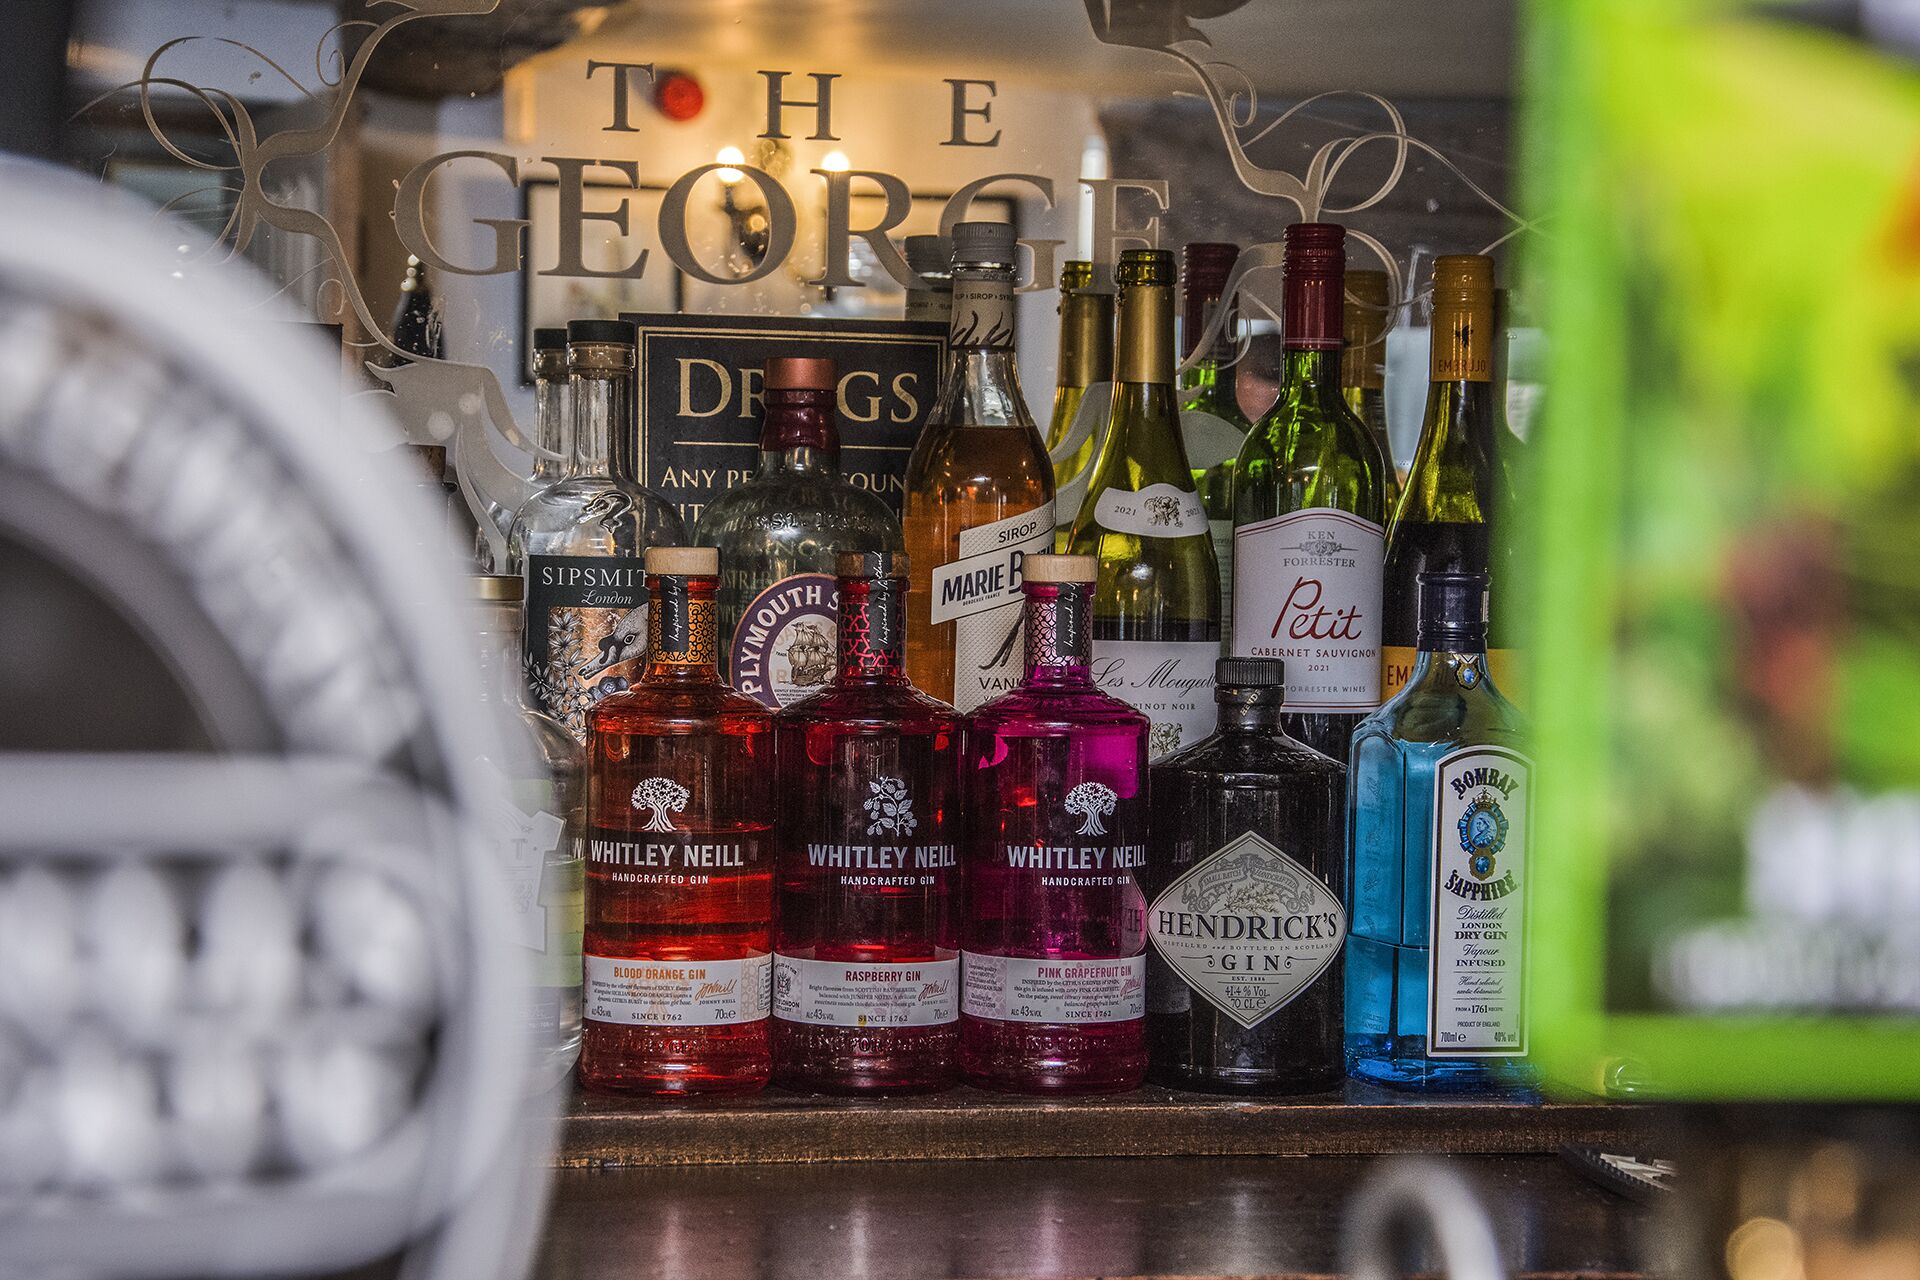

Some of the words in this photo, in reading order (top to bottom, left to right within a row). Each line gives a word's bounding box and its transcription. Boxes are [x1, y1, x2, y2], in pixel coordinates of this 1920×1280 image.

[587, 59, 1002, 147] THE
[395, 150, 1170, 292] GEORGE
[661, 466, 716, 489] ANY
[1114, 505, 1137, 517] 2021
[998, 521, 1038, 544] SIROP
[1308, 531, 1336, 540] KEN
[1284, 557, 1356, 568] FORRESTER
[541, 566, 647, 588] SIPSMIT
[941, 564, 1005, 606] MARIE
[581, 589, 633, 605] London
[1271, 576, 1363, 640] Petit
[669, 601, 681, 642] Inspired
[1067, 603, 1077, 648] Inspired
[740, 585, 822, 694] PLYMOUTH
[1251, 647, 1310, 658] CABERNET
[1315, 648, 1377, 659] SAUVIGNON
[1092, 657, 1125, 688] Les
[1308, 664, 1330, 672] 2021
[1342, 685, 1367, 693] WINES
[1450, 767, 1519, 801] BOMBAY
[590, 839, 675, 867] WHITLEY
[683, 844, 744, 867] NEILL
[808, 843, 908, 869] WHITLEY
[915, 844, 957, 869] NEILL
[1007, 845, 1107, 869] WHITLEY
[1112, 844, 1147, 869] NEILL
[612, 872, 684, 884] HANDCRAFTED
[689, 875, 709, 885] GIN
[840, 875, 916, 886] HANDCRAFTED
[920, 876, 935, 885] GIN
[1041, 876, 1113, 886] HANDCRAFTED
[1117, 875, 1130, 885] GIN
[1443, 868, 1521, 901] SAPPHIRE
[1456, 904, 1508, 920] Distilled
[1158, 910, 1338, 941] HENDRICK'S
[1454, 931, 1481, 940] DRY
[1483, 931, 1508, 940] GIN
[1163, 940, 1208, 949] DISTILLED
[1294, 942, 1334, 951] SCOTLAND
[1462, 943, 1499, 959] Vapour
[1221, 954, 1280, 971] GIN
[1455, 959, 1506, 967] INFUSED
[613, 966, 643, 979] BLOOD
[645, 968, 685, 980] ORANGE
[688, 968, 706, 980] GIN
[845, 970, 903, 982] RASPBERRY
[905, 970, 921, 982] GIN
[1037, 967, 1062, 978] PINK
[1064, 966, 1119, 979] GRAPEFRUIT
[1120, 965, 1132, 976] GIN
[1231, 998, 1241, 1008] 70
[1471, 1004, 1489, 1014] 1761
[631, 1012, 659, 1021] SINCE
[662, 1013, 682, 1021] 1762
[858, 1014, 887, 1022] SINCE
[889, 1014, 908, 1022] 1762
[1064, 1010, 1092, 1018] SINCE
[1094, 1010, 1112, 1018] 1762
